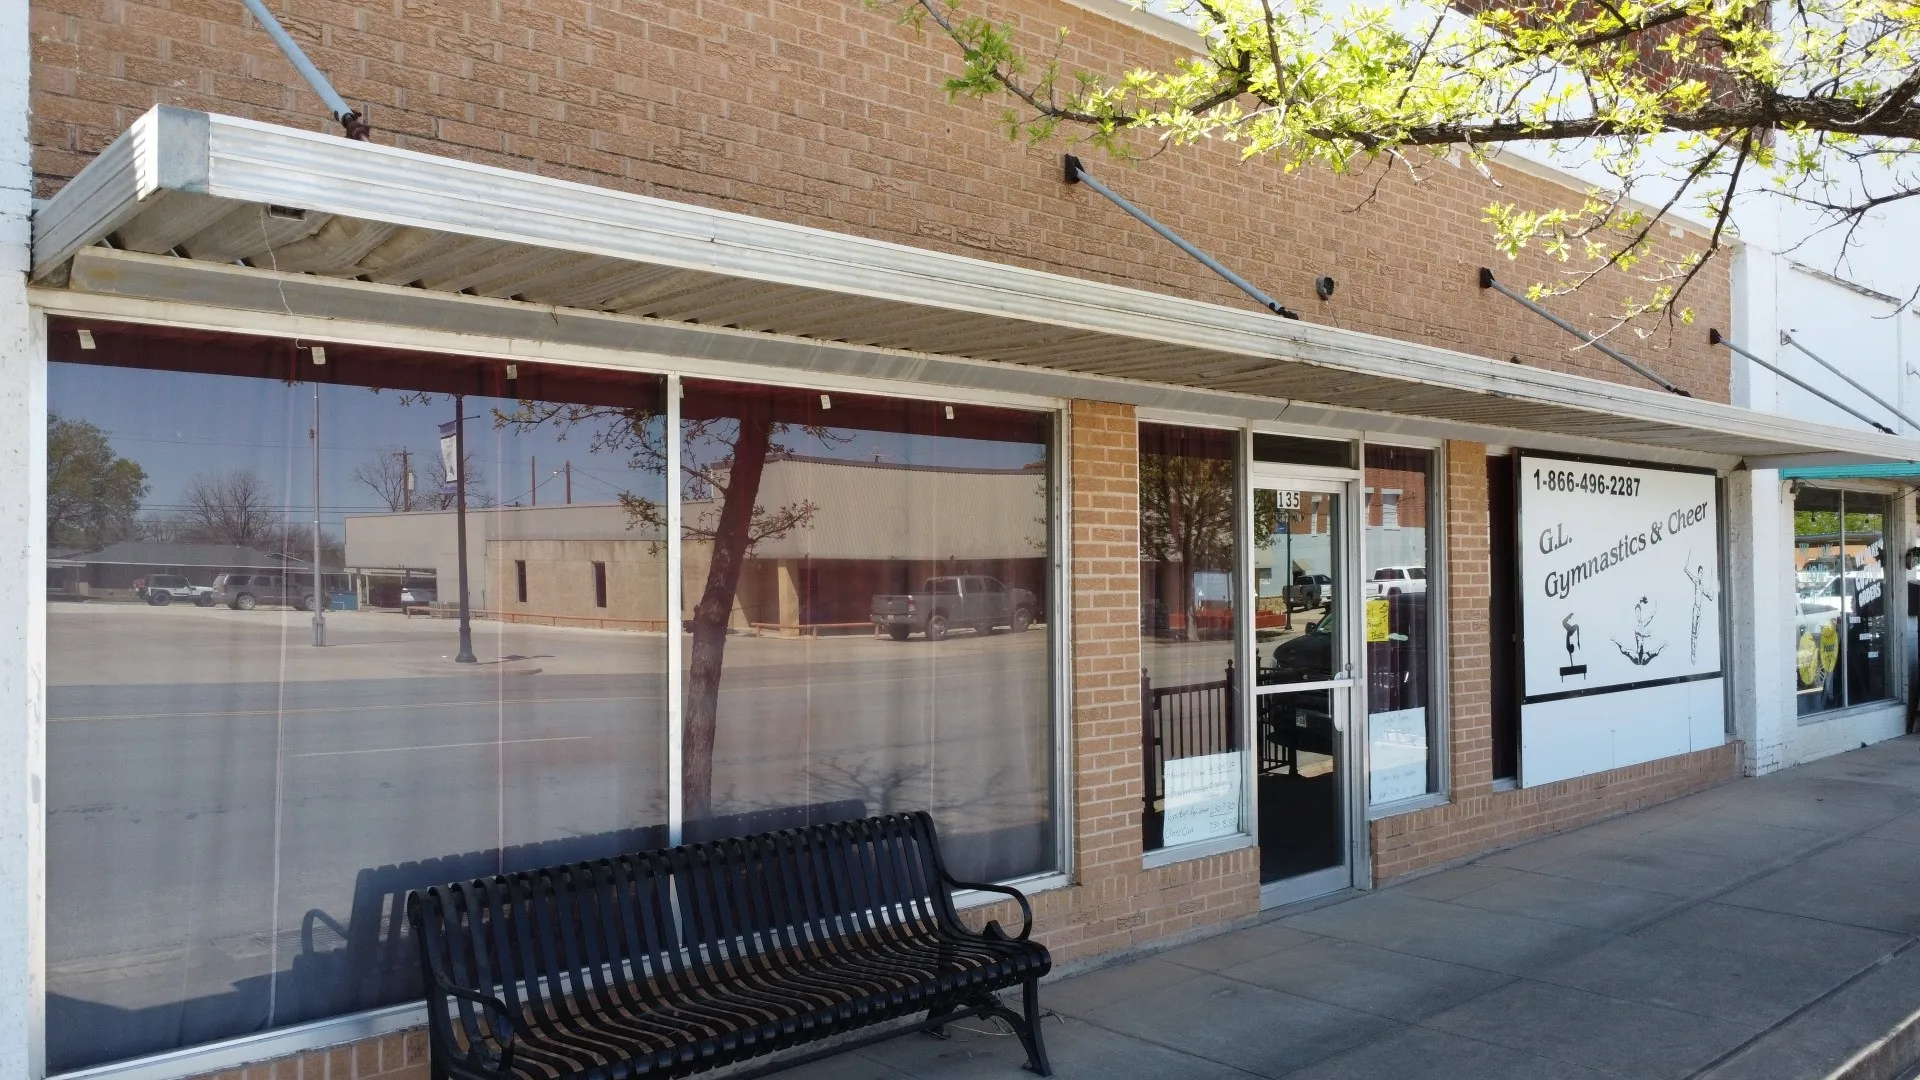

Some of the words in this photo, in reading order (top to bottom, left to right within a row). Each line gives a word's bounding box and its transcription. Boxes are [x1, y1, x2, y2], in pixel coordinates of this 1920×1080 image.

[1533, 468, 1641, 498] 1-866-496-2287
[1278, 492, 1300, 508] 135
[1539, 522, 1573, 555] G.L.
[1544, 533, 1647, 599] Gymnastics
[1650, 521, 1664, 545] &
[1667, 501, 1708, 536] Cheer
[1858, 582, 1882, 608] ORDERS
